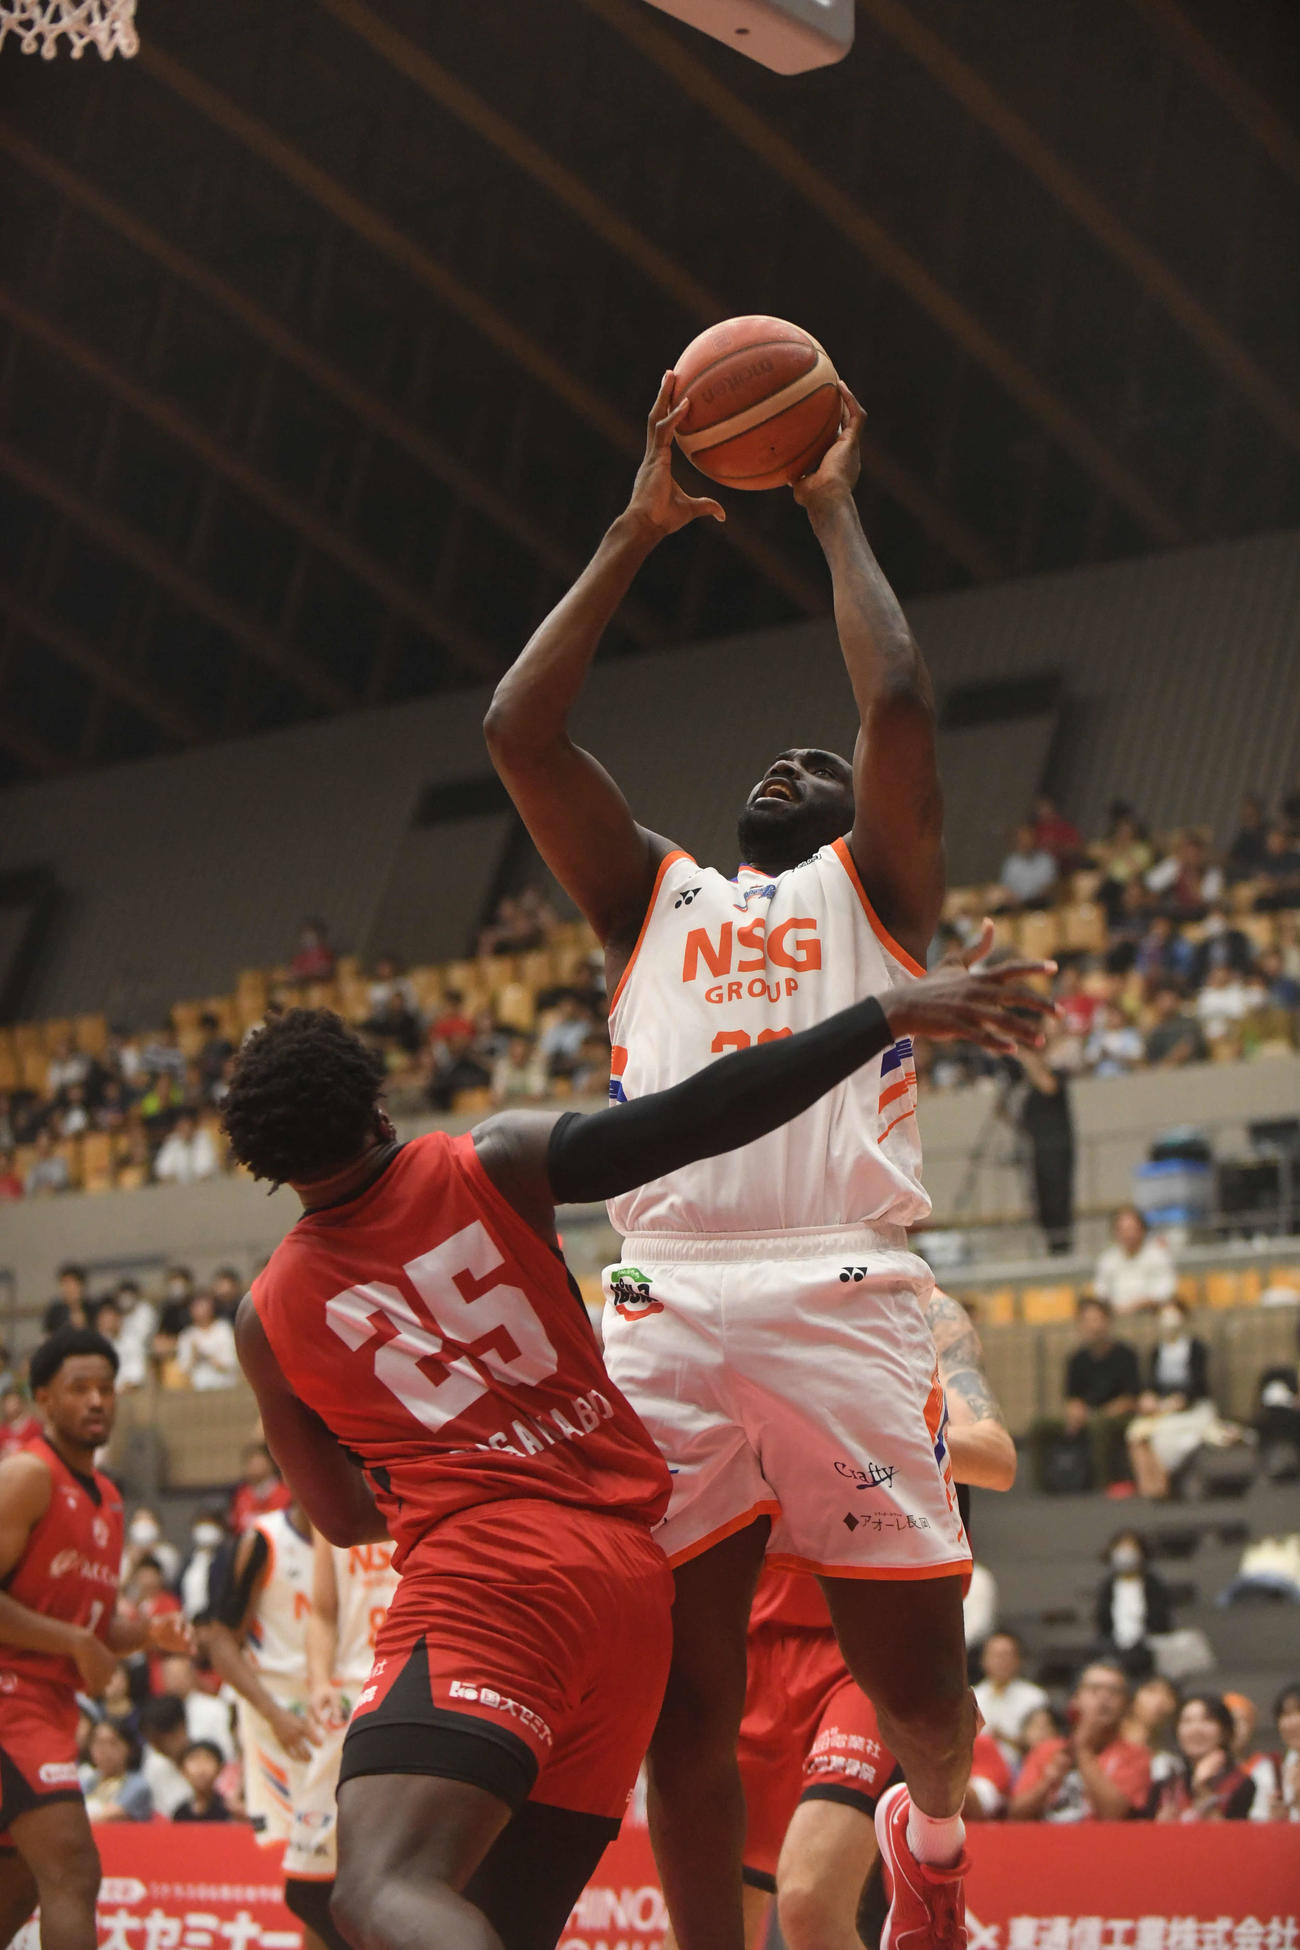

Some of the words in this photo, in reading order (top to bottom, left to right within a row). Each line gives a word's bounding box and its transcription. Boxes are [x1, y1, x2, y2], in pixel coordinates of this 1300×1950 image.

[682, 917, 822, 983] NSG
[704, 977, 799, 1004] GROUP
[325, 1219, 558, 1434] 25
